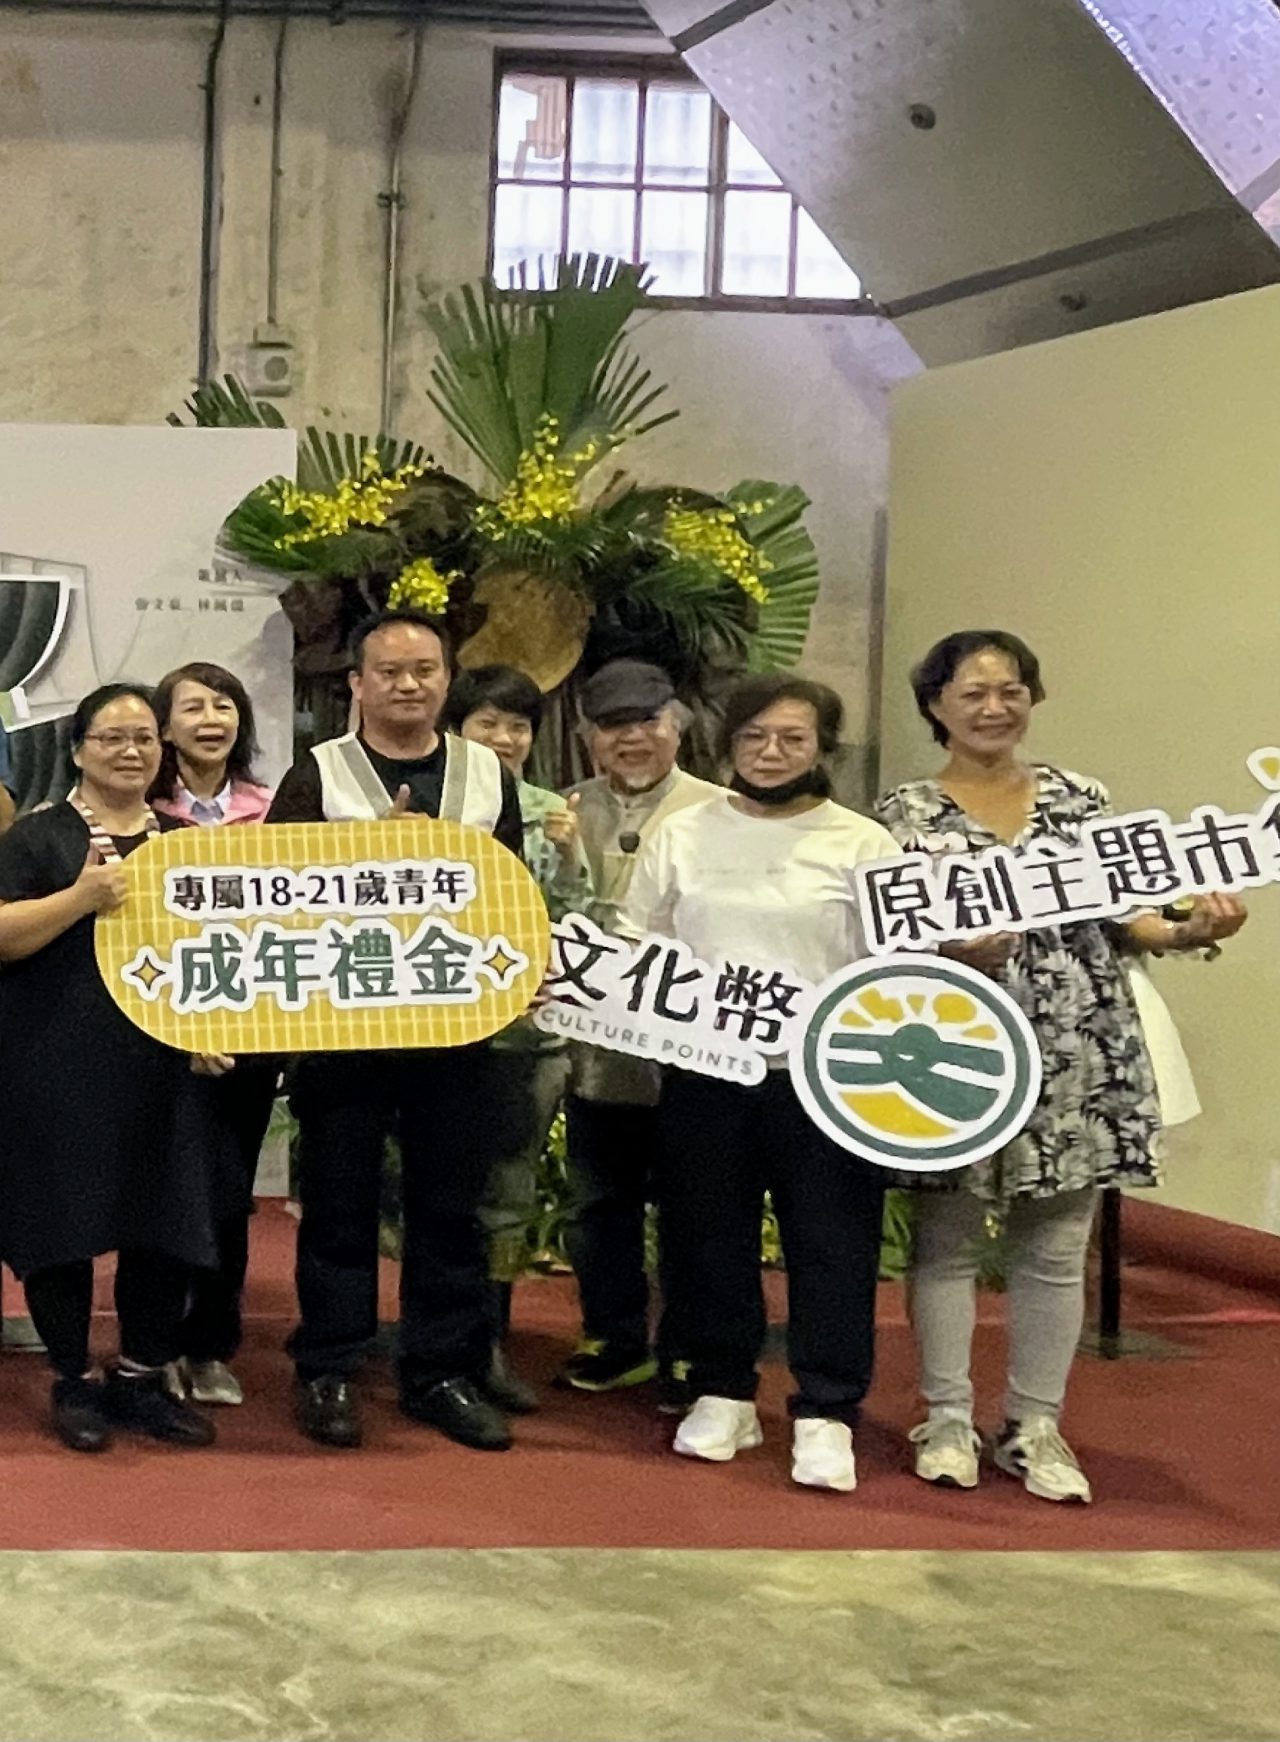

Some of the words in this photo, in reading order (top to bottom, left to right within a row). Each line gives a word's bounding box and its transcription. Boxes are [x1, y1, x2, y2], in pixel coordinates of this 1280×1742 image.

[861, 802, 1280, 946] 原創主題市
[178, 924, 476, 1005] 成年禮金
[544, 922, 803, 1044] 文化幣
[540, 1007, 651, 1049] CULTURE
[661, 1038, 754, 1076] POINTS
